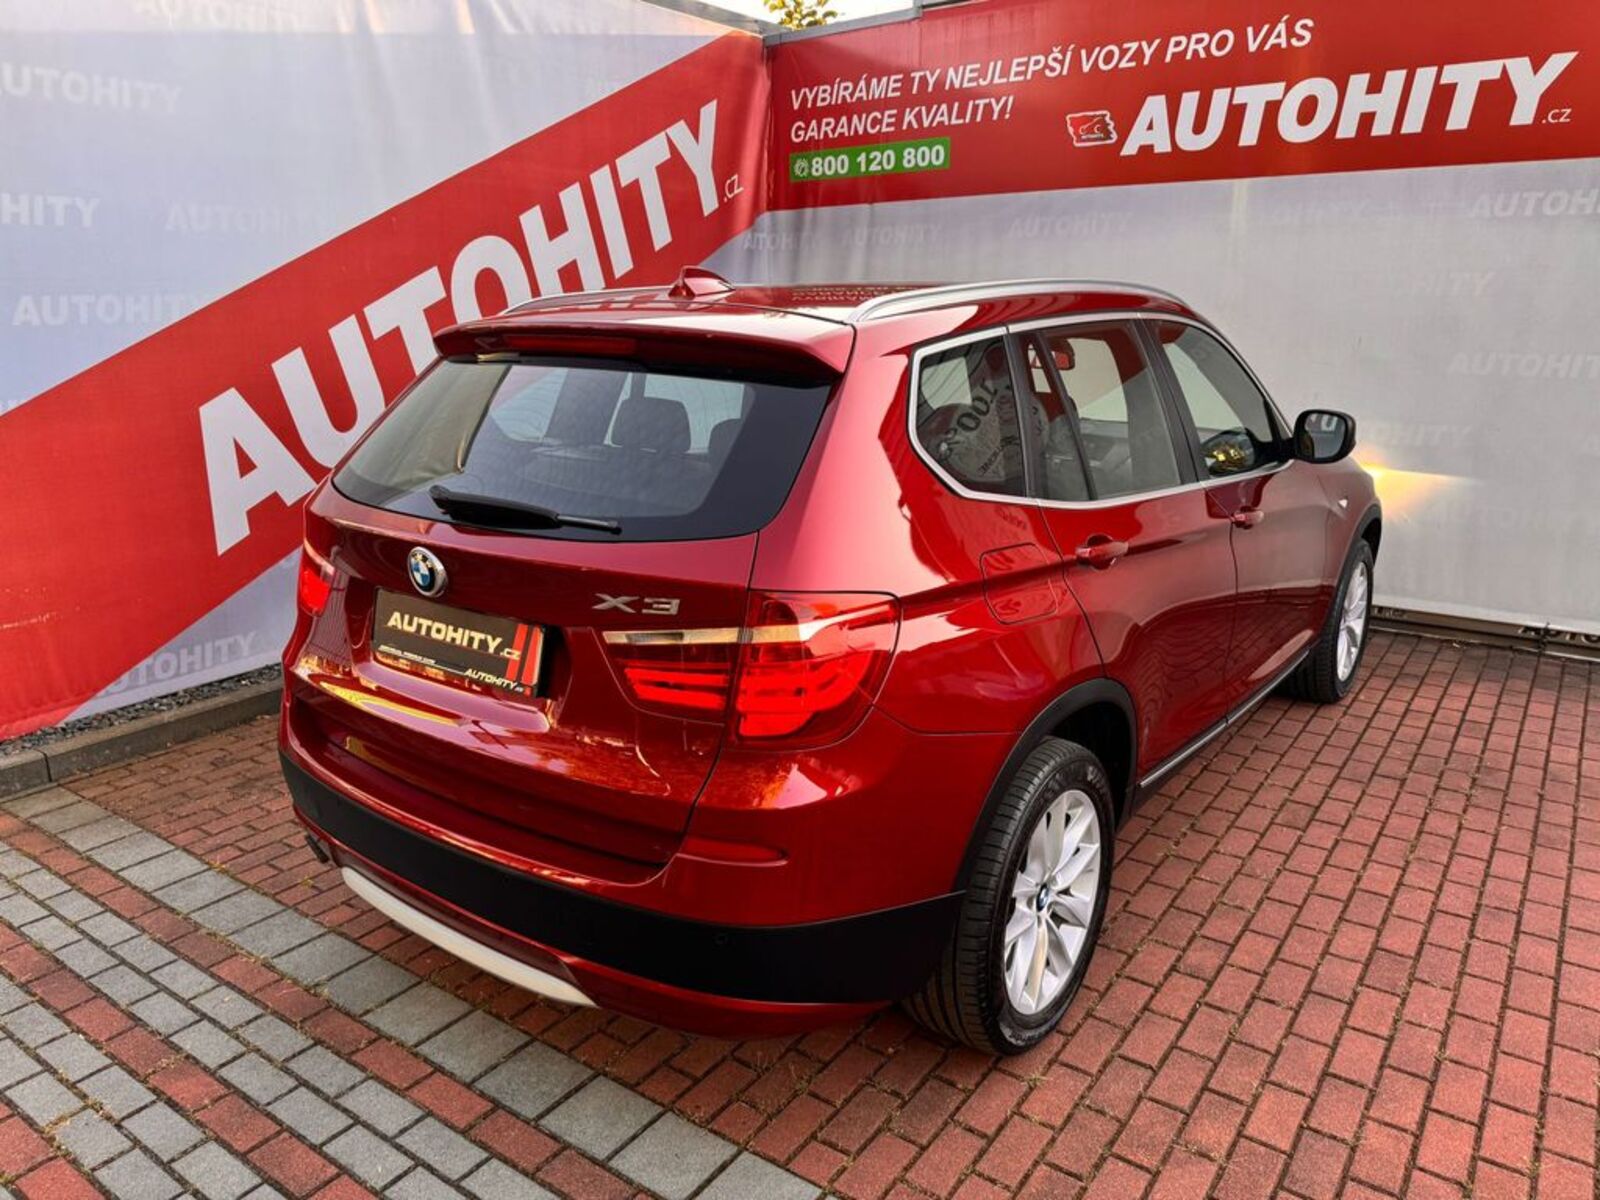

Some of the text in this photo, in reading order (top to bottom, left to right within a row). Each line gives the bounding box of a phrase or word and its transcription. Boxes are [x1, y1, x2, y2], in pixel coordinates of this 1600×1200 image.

[791, 15, 1315, 110] VYBÍRÁME TY NEJLEPŠÍ VOZY PRO VÁS
[0, 61, 182, 114] UTOHITY
[791, 95, 1015, 143] GARANCE KVALITY!
[811, 144, 945, 177] 800 120 800
[11, 294, 210, 327] AUTOHIT
[592, 592, 681, 615] X3
[108, 633, 257, 690] TOHITY
